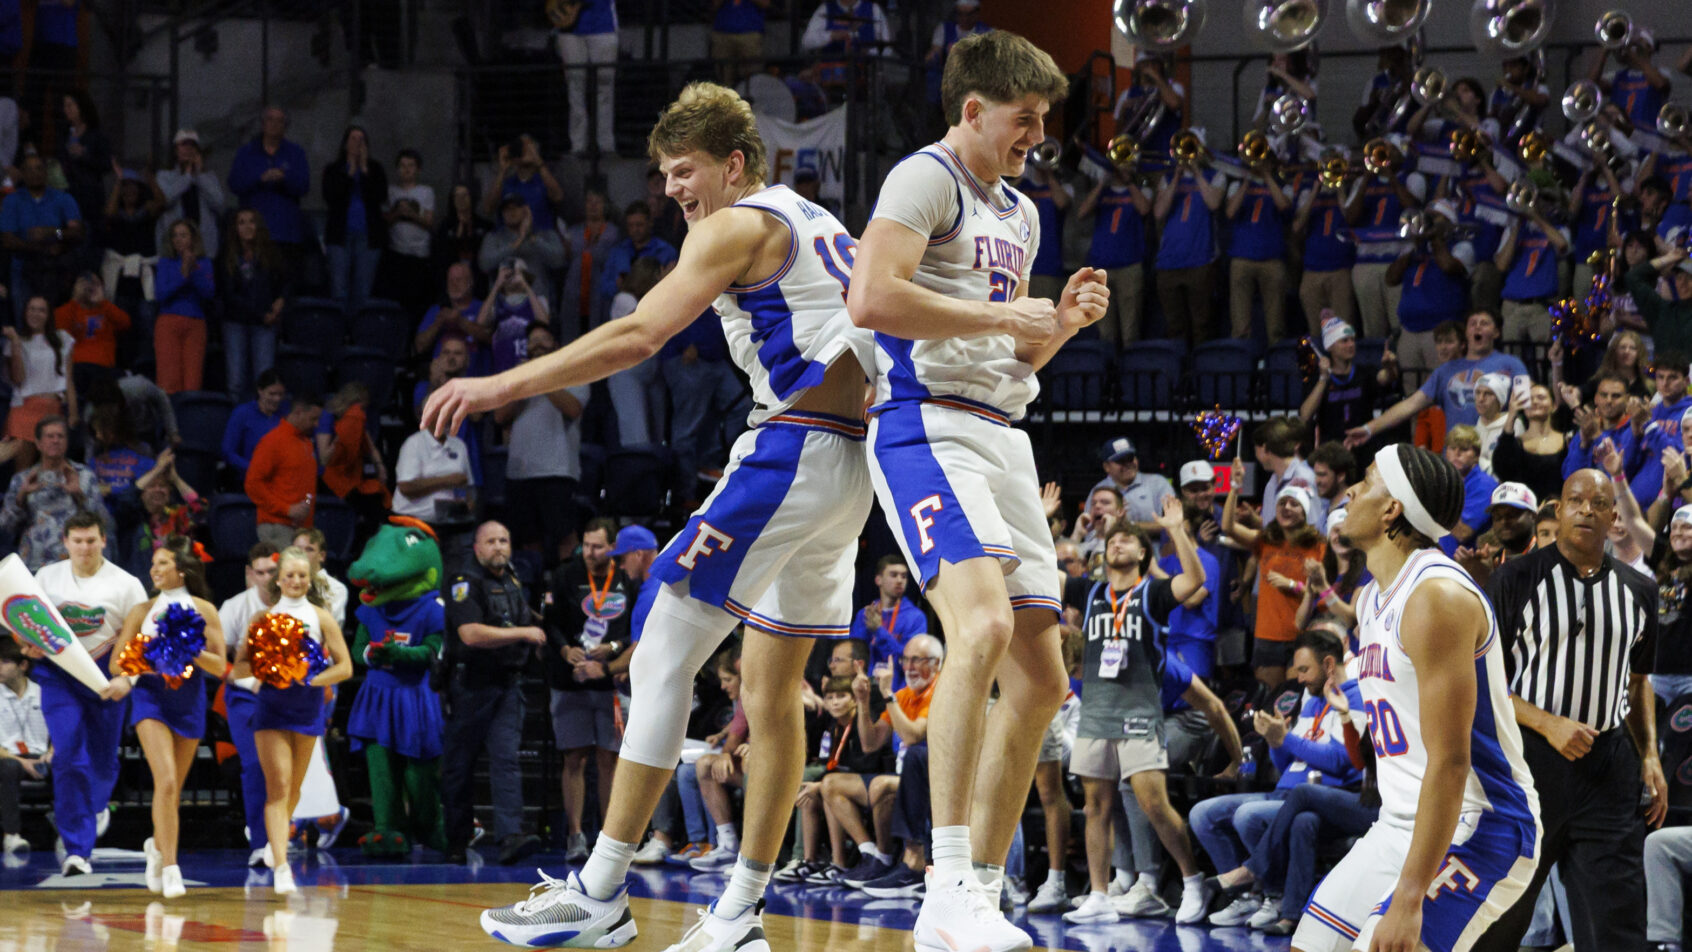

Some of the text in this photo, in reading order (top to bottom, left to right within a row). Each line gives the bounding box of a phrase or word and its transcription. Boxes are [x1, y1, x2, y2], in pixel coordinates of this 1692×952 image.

[796, 200, 829, 221] HAU
[1110, 207, 1123, 234] 1
[1251, 198, 1263, 223] 1
[1323, 210, 1333, 236] 1
[1374, 198, 1387, 225] 1
[972, 235, 1027, 278] FLORID
[1525, 250, 1539, 277] 1
[910, 494, 943, 555] F
[676, 520, 735, 571] F
[1088, 611, 1142, 641] UTAH
[1364, 698, 1410, 758] 20
[1425, 853, 1480, 901] F
